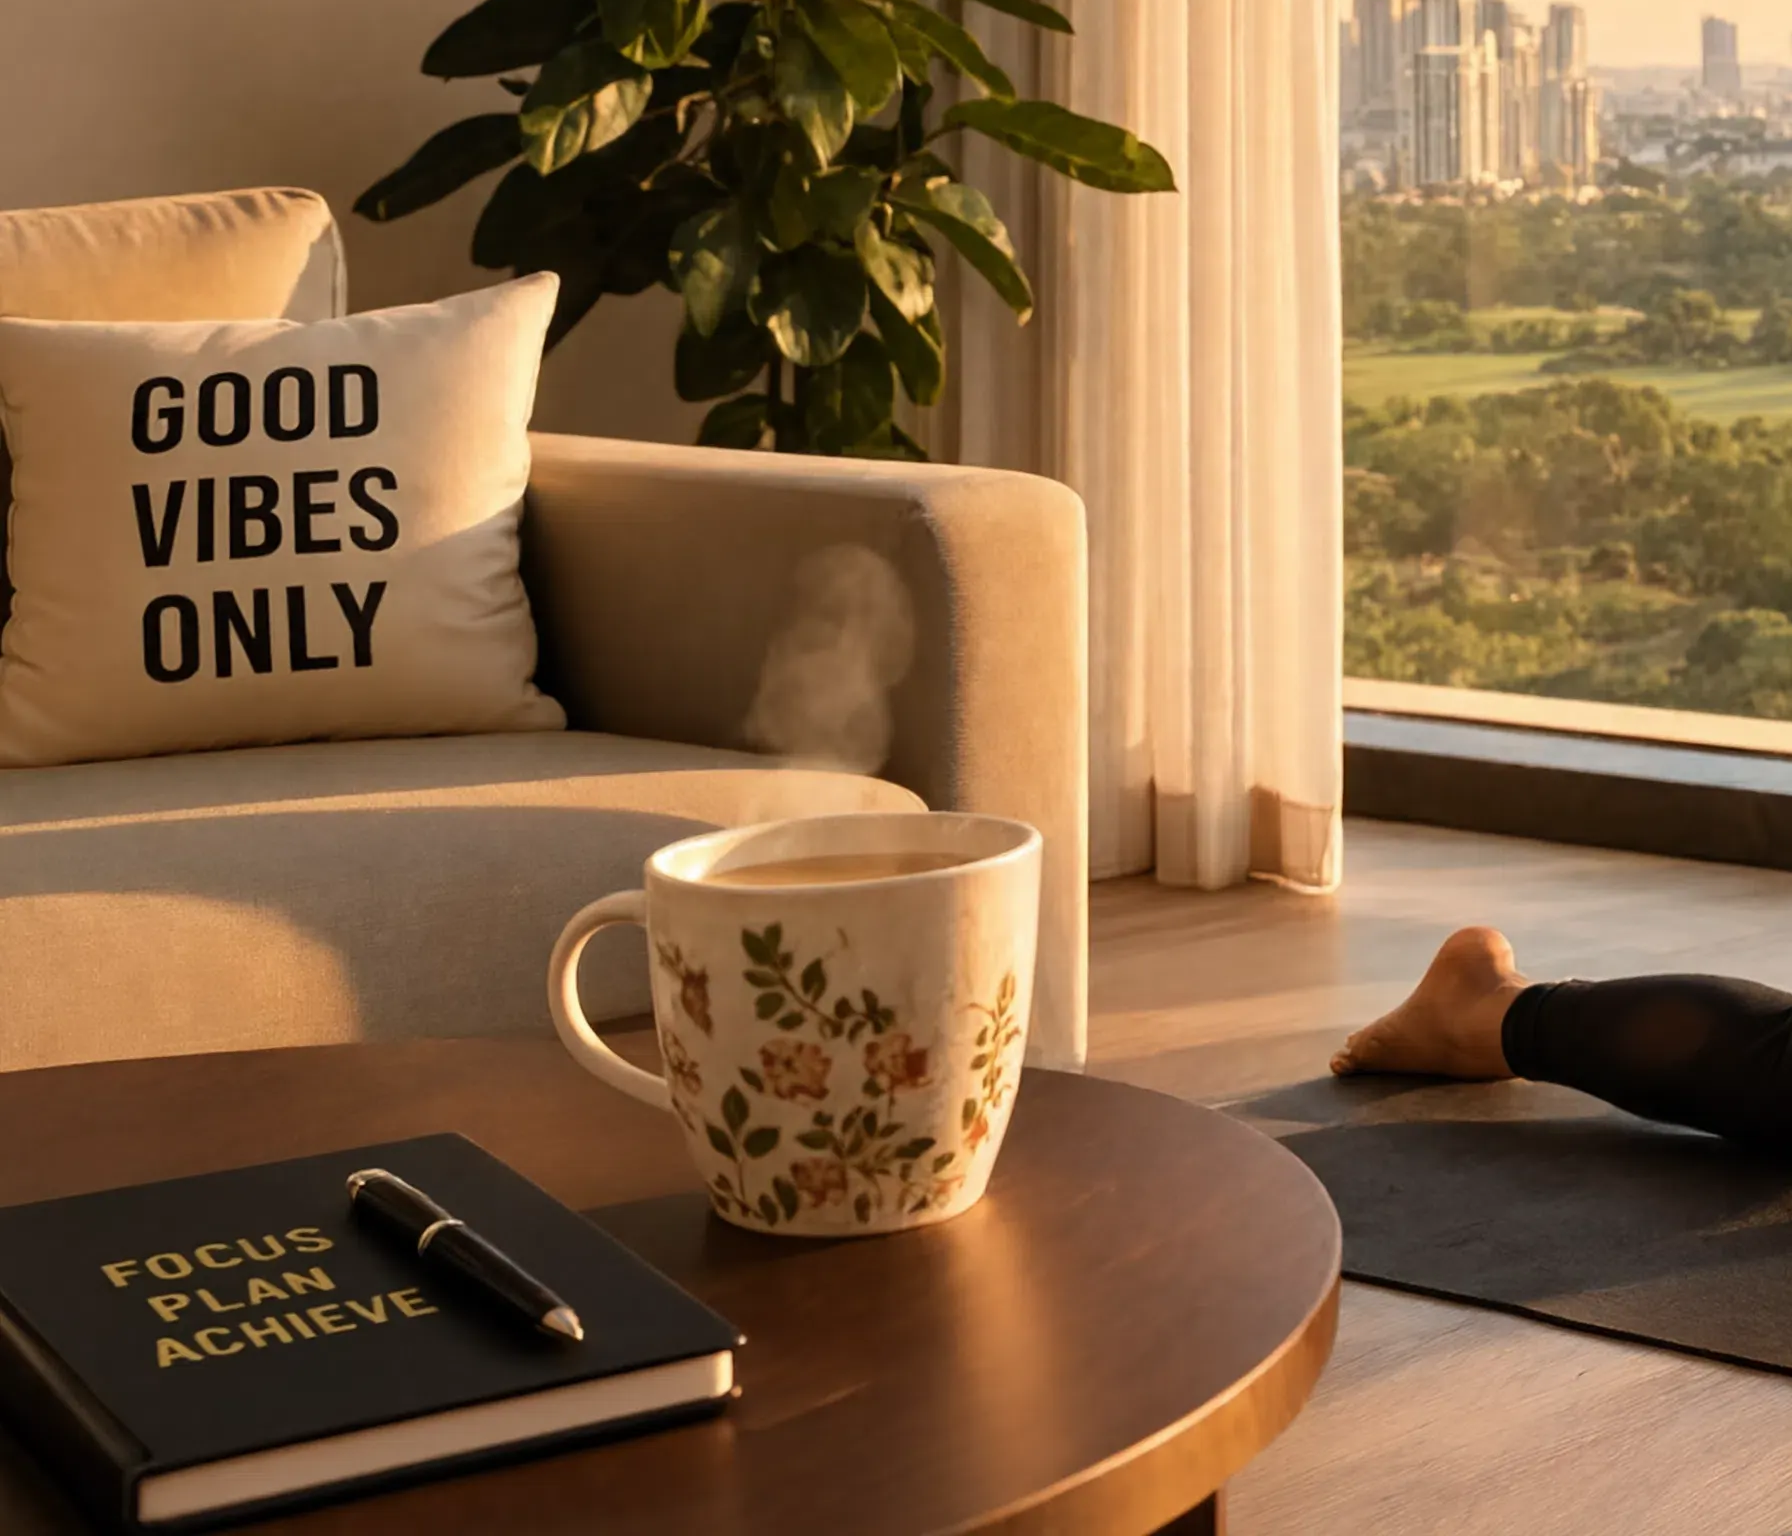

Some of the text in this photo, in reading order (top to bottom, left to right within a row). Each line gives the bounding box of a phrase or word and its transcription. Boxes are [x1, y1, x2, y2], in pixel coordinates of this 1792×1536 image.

[132, 365, 378, 454] GOOD
[132, 467, 398, 567] VIBES
[143, 582, 386, 683] ONLY
[102, 1227, 335, 1287] FOCUS
[148, 1268, 335, 1321] PLAN
[156, 1288, 439, 1368] ACHIEVE
